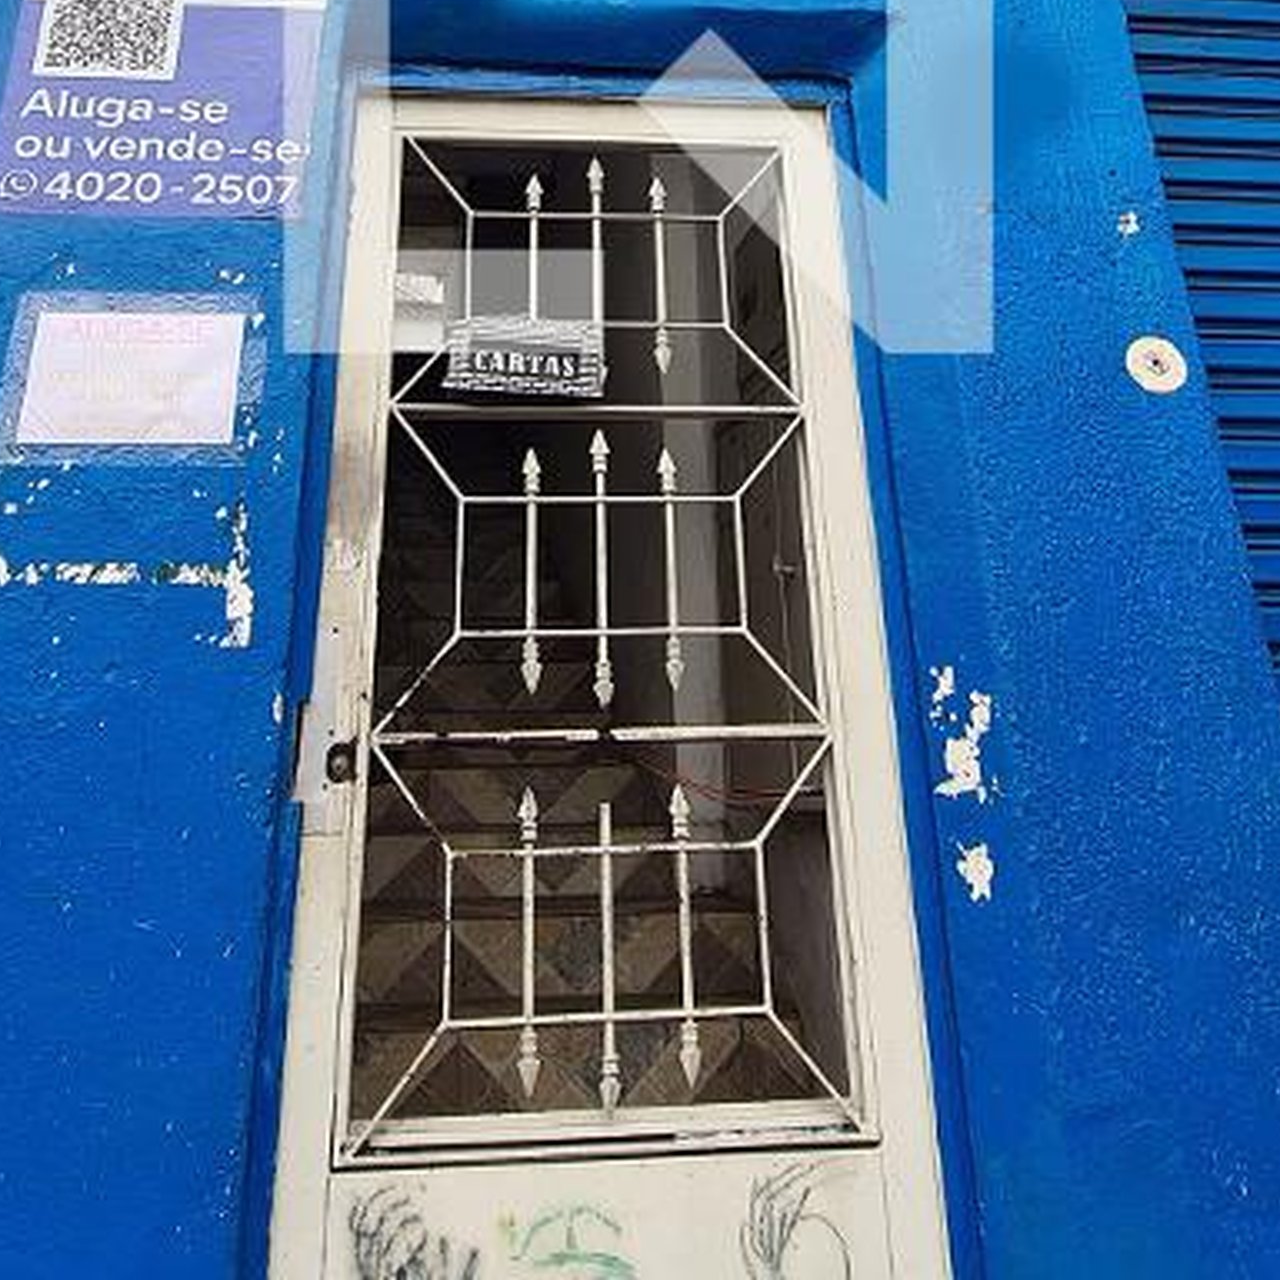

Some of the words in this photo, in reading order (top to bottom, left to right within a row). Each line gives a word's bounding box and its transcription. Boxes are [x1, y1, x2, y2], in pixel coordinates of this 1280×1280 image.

[21, 88, 229, 128] Aluga-se
[14, 136, 70, 159] ou
[86, 132, 302, 163] vende-se
[473, 350, 576, 377] CARTAS
